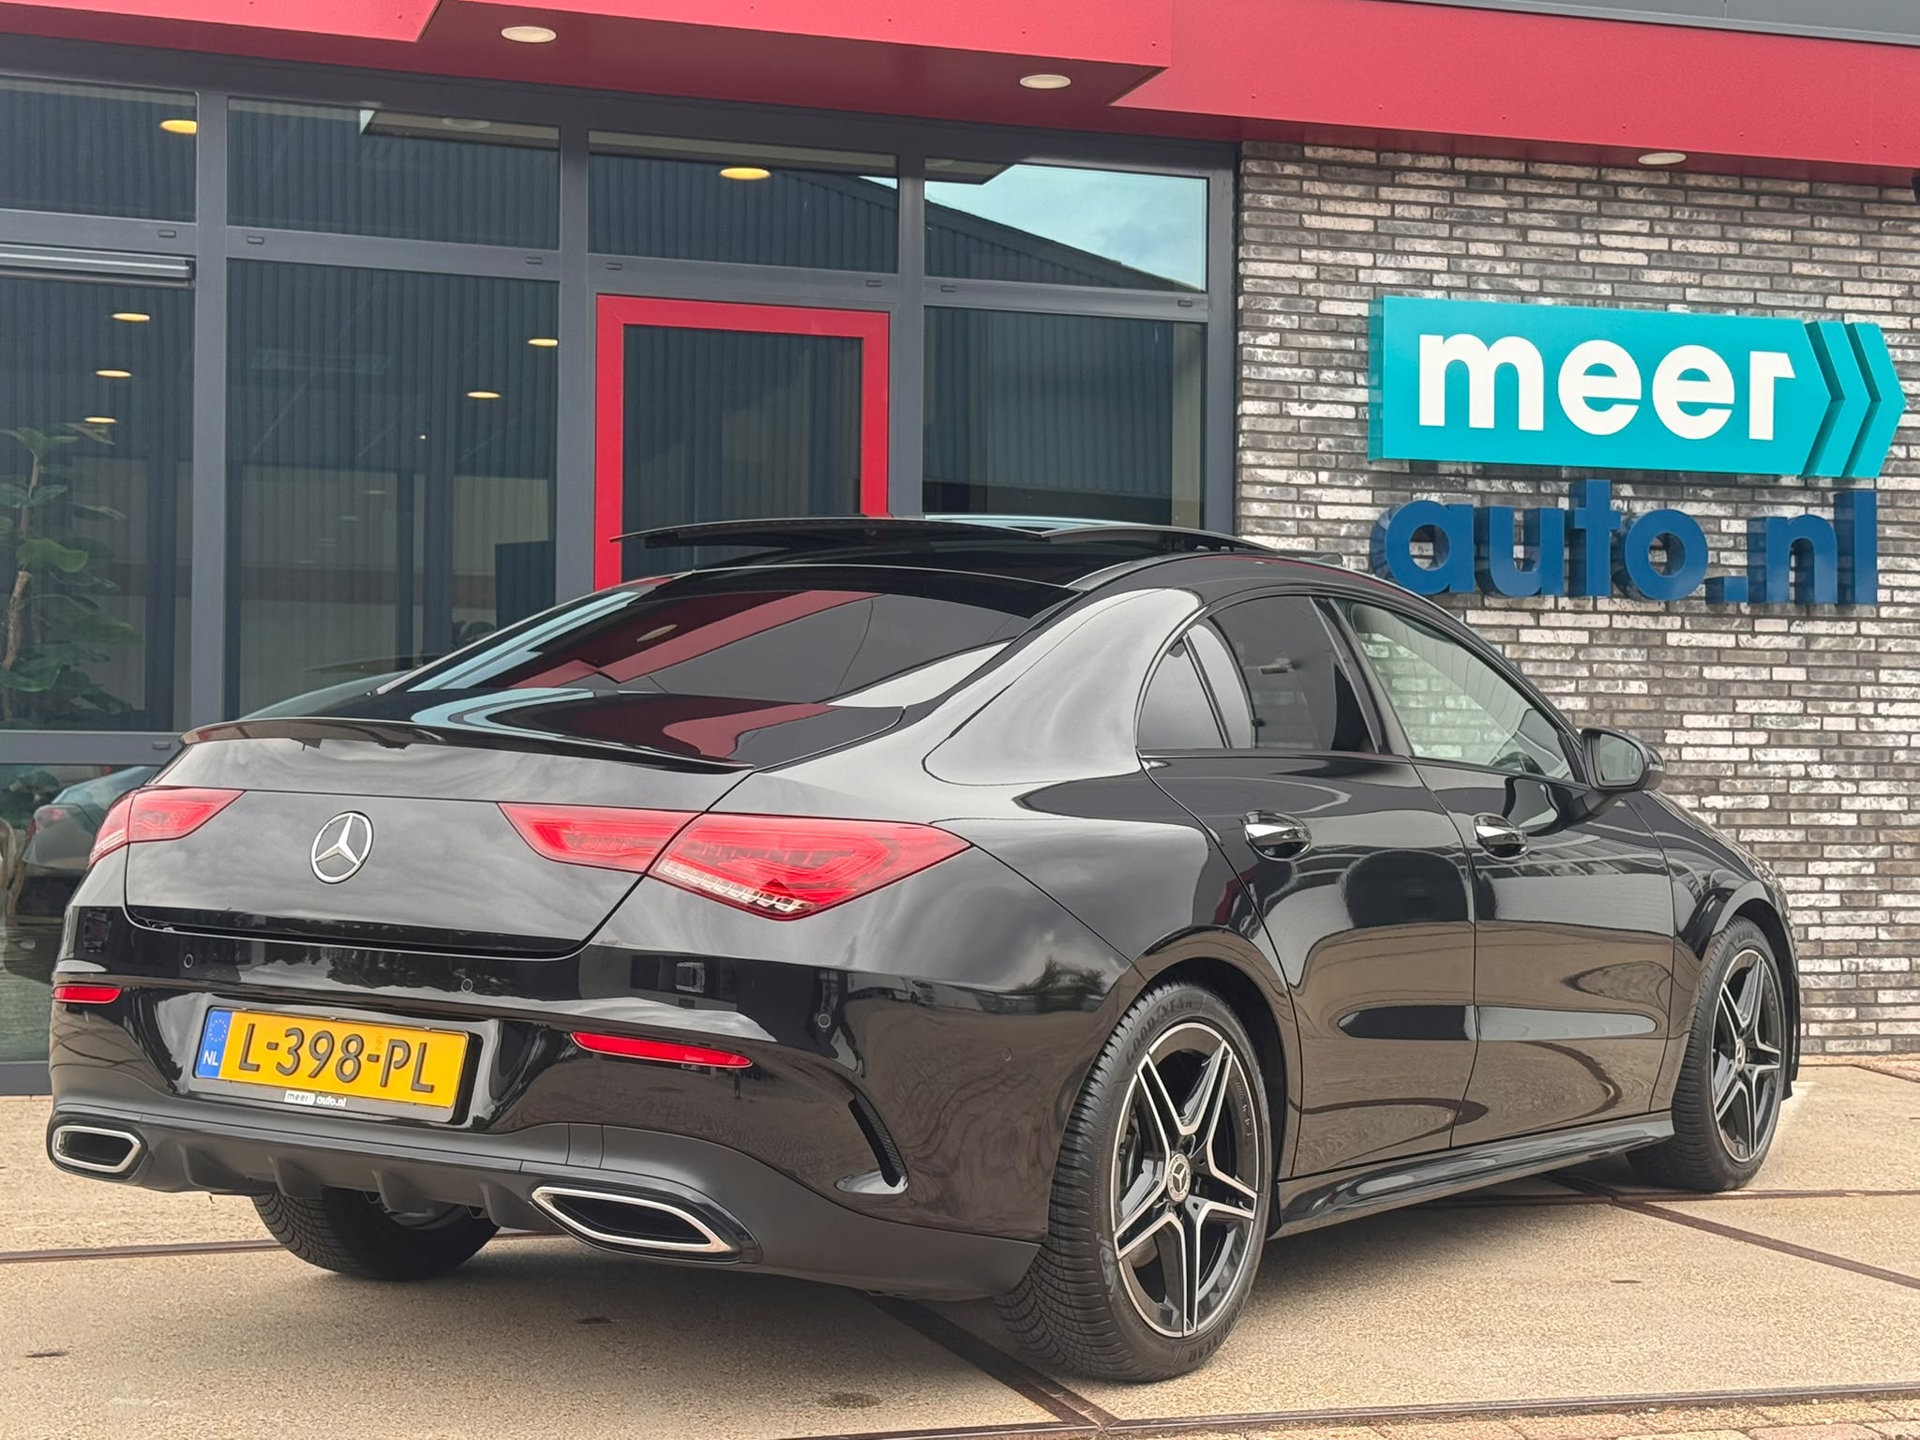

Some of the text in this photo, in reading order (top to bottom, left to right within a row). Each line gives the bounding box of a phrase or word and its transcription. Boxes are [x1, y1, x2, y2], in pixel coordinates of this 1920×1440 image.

[1418, 332, 1796, 441] meer
[1370, 478, 1878, 606] auto.nl
[202, 1050, 220, 1067] NL
[238, 1022, 435, 1094] L-398-PL
[286, 1092, 347, 1108] meer auto.nl
